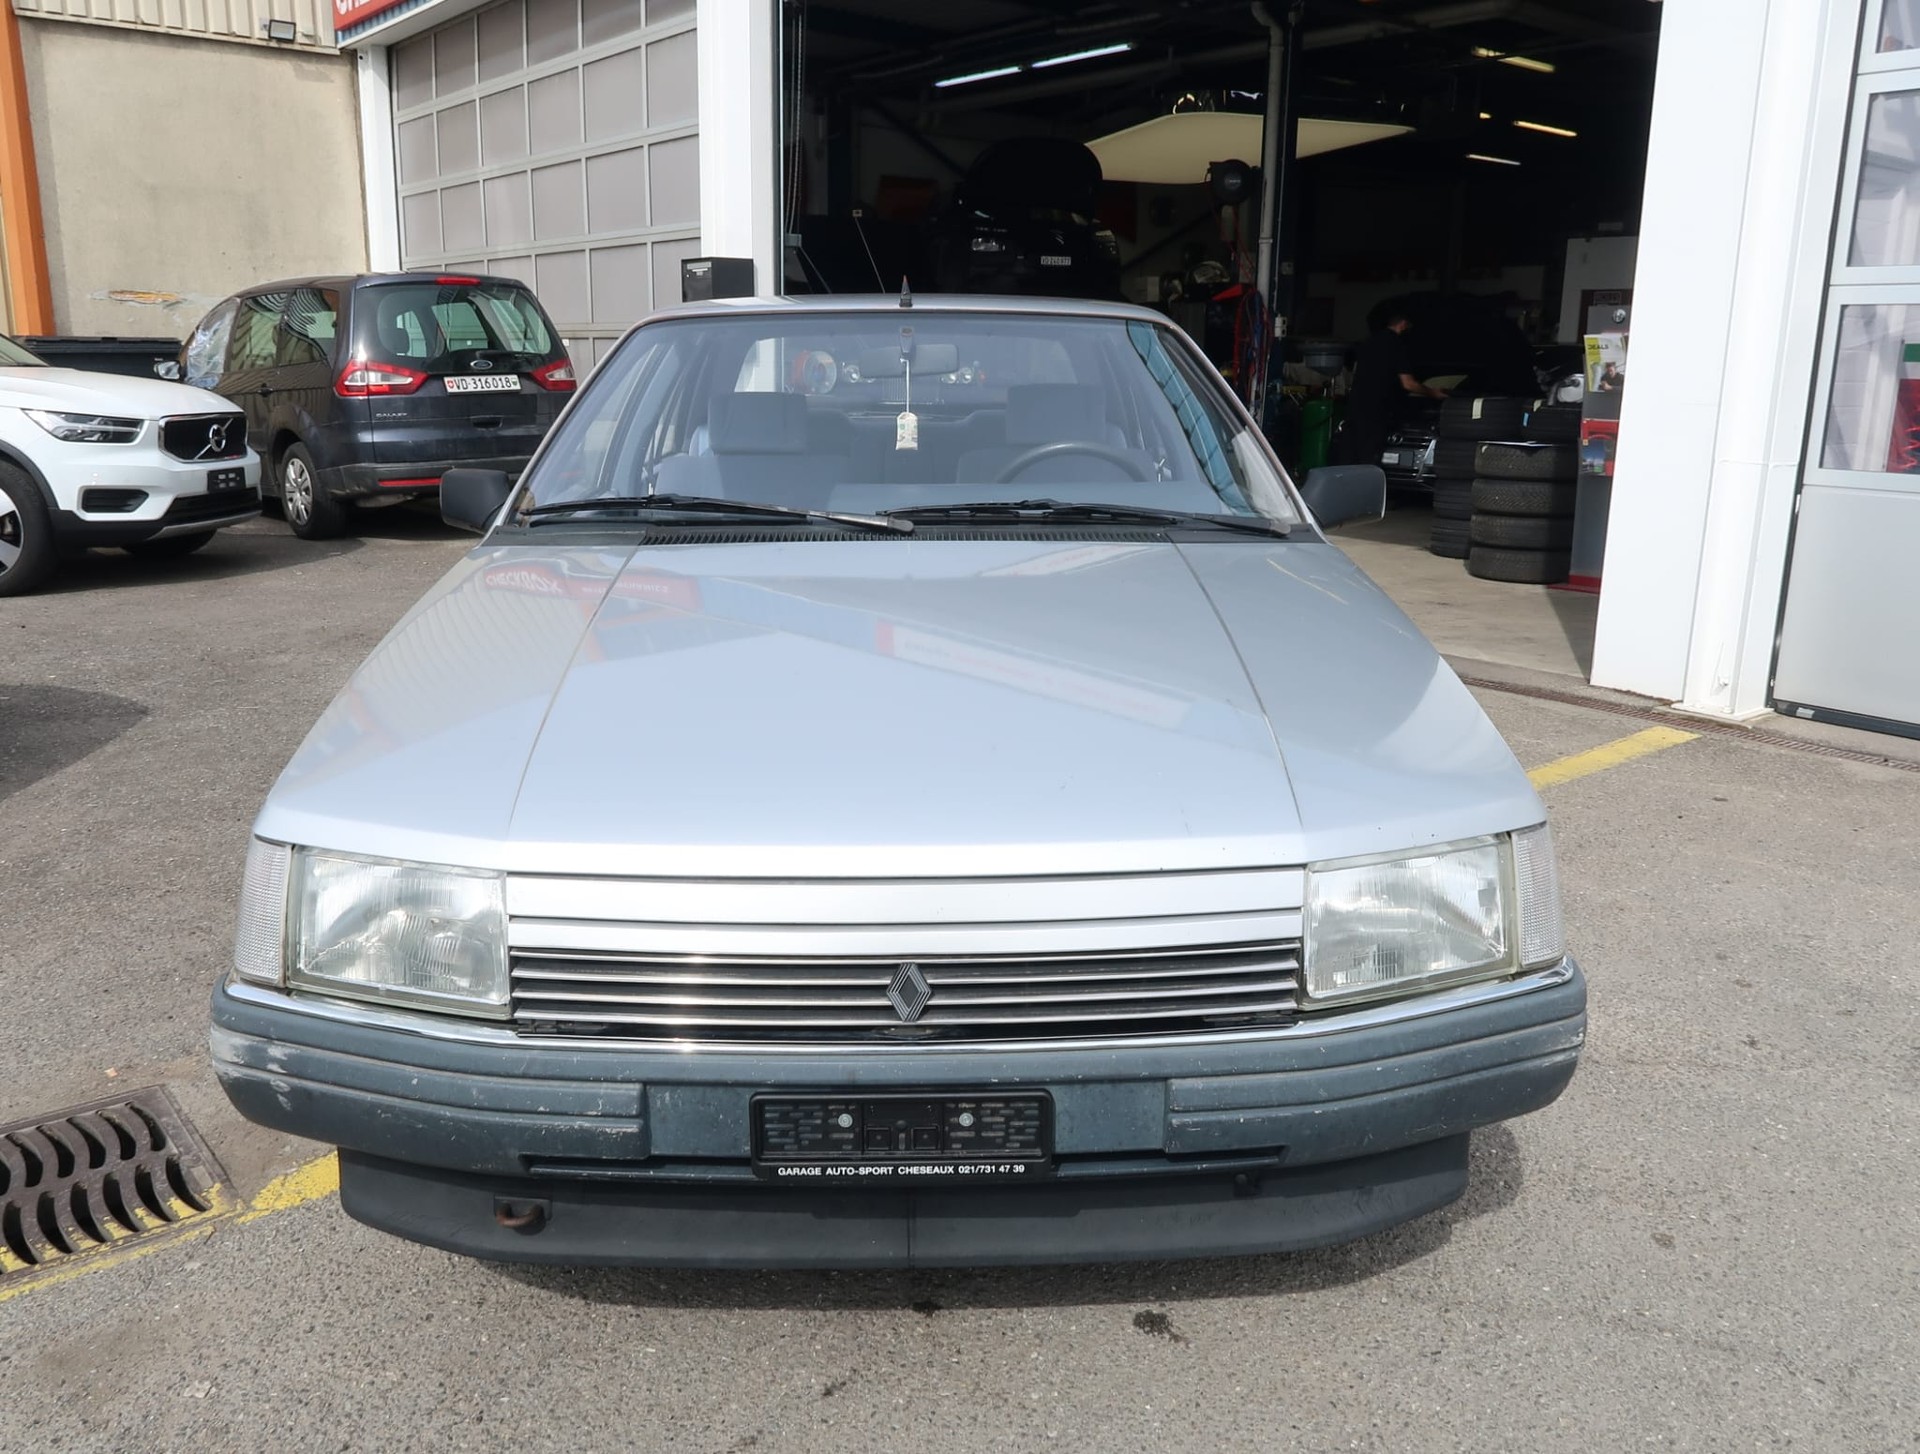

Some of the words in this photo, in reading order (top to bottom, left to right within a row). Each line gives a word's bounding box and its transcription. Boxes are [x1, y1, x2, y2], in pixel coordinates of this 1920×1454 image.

[778, 1166, 822, 1176] GARAGE
[825, 1166, 894, 1176] AUTO-SPORT
[897, 1165, 954, 1175] CHESEAUX
[958, 1164, 996, 1175] 021/731
[998, 1164, 1010, 1174] 47
[1012, 1164, 1025, 1174] 39
